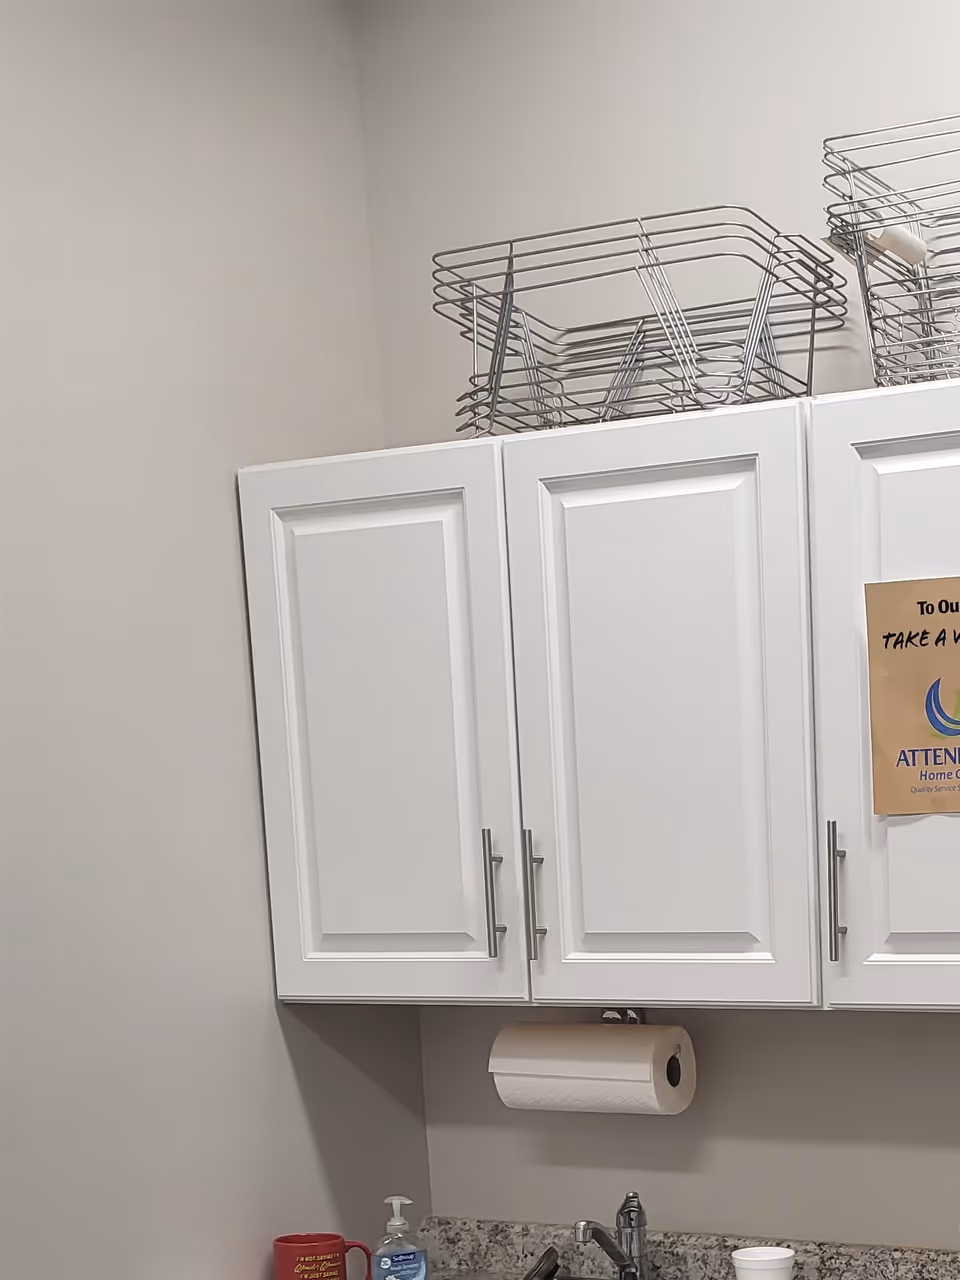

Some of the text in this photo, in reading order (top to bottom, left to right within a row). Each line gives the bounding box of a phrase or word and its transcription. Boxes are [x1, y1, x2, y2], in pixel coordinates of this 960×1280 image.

[917, 600, 935, 615] To
[882, 629, 931, 650] TAKE
[934, 628, 947, 648] A
[920, 770, 953, 781] Home
[910, 785, 934, 795] Quality
[934, 784, 956, 793] Service
